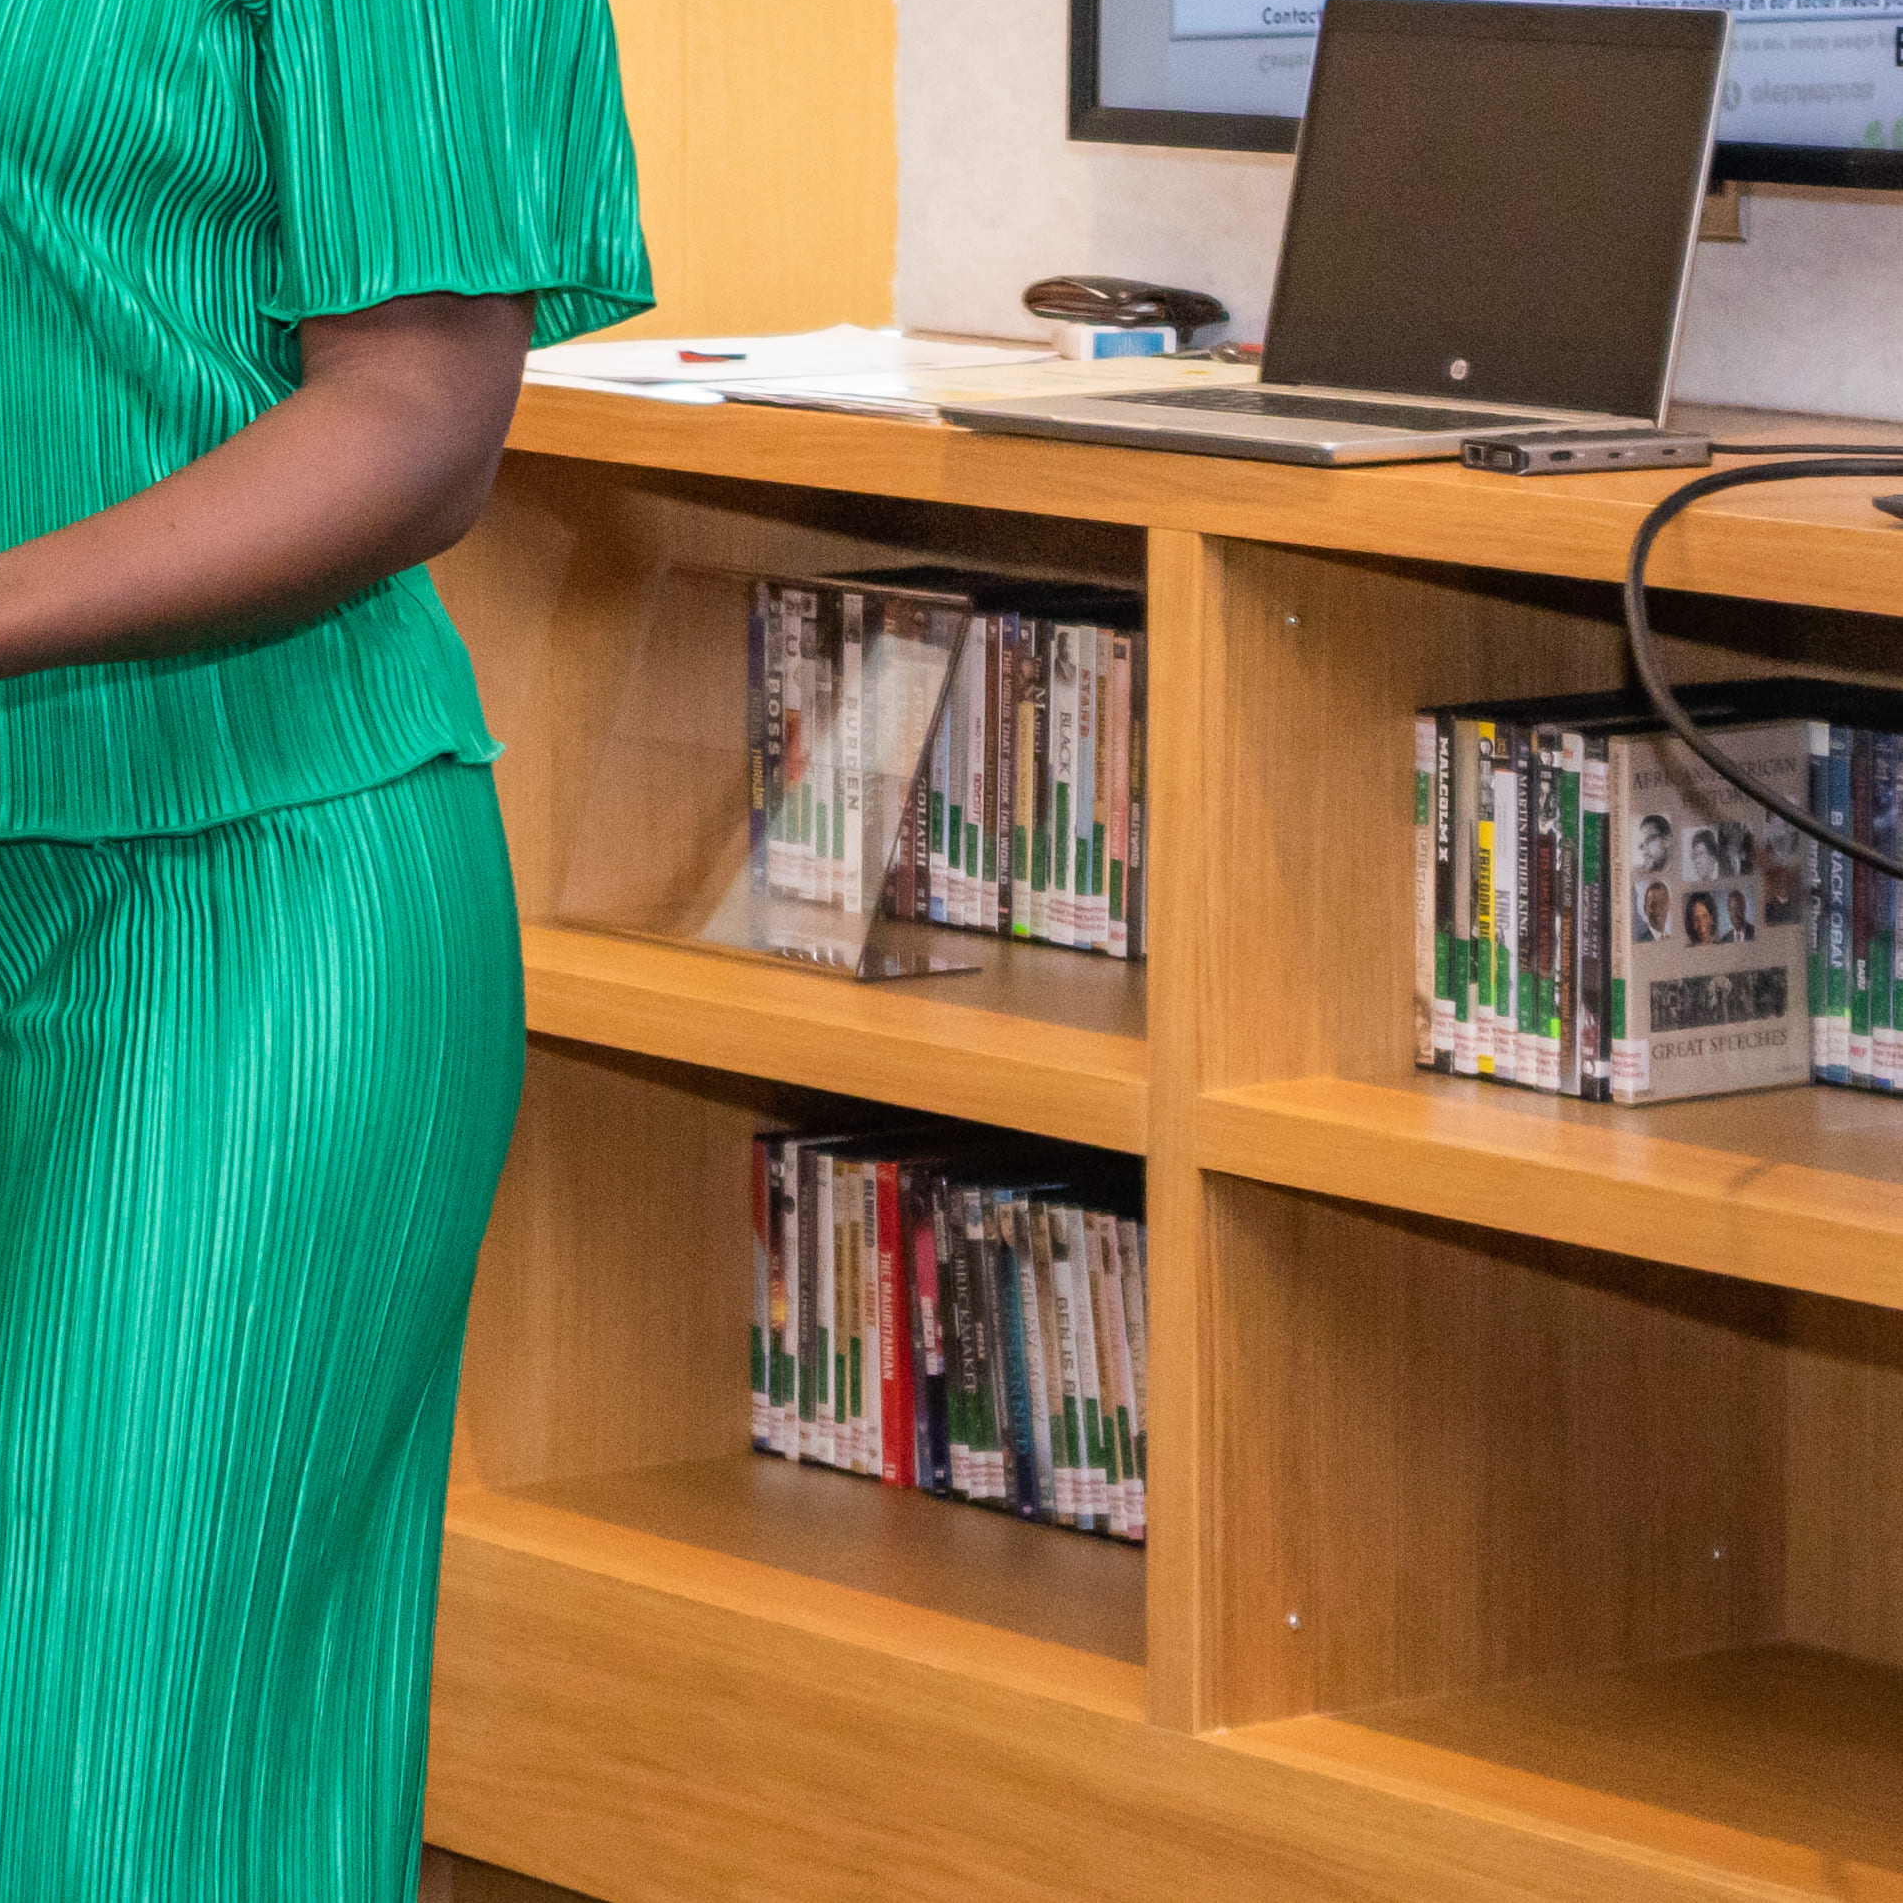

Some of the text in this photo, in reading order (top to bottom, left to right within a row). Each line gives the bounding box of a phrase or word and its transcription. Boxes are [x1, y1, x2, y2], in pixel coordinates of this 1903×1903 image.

[1001, 649, 1013, 675] THE
[767, 677, 782, 757] BOSS
[1079, 668, 1091, 740] STAND
[845, 697, 859, 812] BURDEN
[1001, 722, 1012, 755] THAT
[1058, 710, 1073, 778] BLACK
[1000, 808, 1010, 833] THE
[1438, 737, 1449, 863] MALCOLM X
[1518, 775, 1529, 833] MARTIN
[999, 836, 1010, 886] WORLD
[1478, 847, 1491, 917] FREEDOM
[1518, 836, 1529, 895] LUTHER
[1830, 809, 1845, 905] BRACK
[1518, 899, 1529, 937] KING
[1651, 1037, 1707, 1061] GREAT
[1709, 1027, 1788, 1055] SPEECHES
[880, 1252, 894, 1381] THE MAURITANIAN
[1055, 1297, 1071, 1341] BEN
[1060, 1350, 1074, 1372] IS
